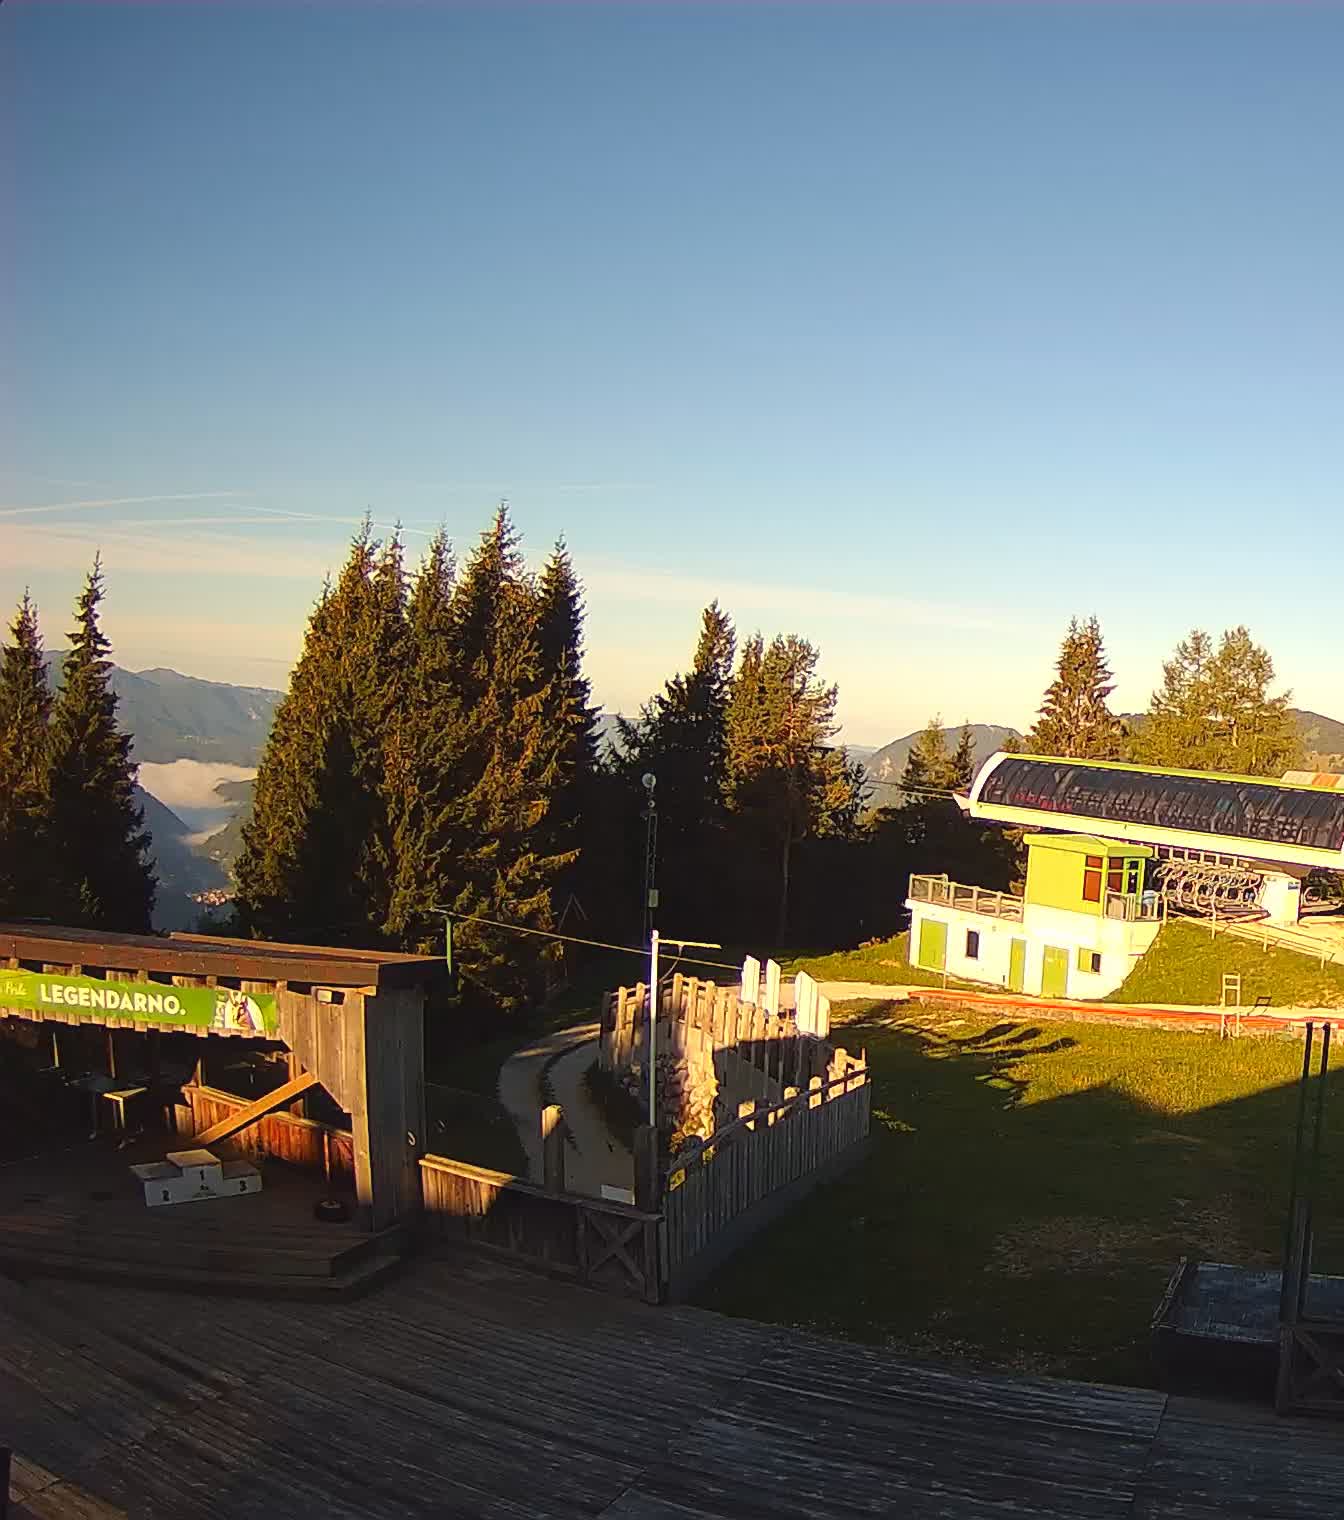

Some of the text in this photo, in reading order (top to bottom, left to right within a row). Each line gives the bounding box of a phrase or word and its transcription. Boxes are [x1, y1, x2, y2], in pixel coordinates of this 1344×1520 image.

[40, 983, 187, 1016] LEGENDARNO.
[239, 1179, 248, 1193] 3
[162, 1189, 170, 1203] 2
